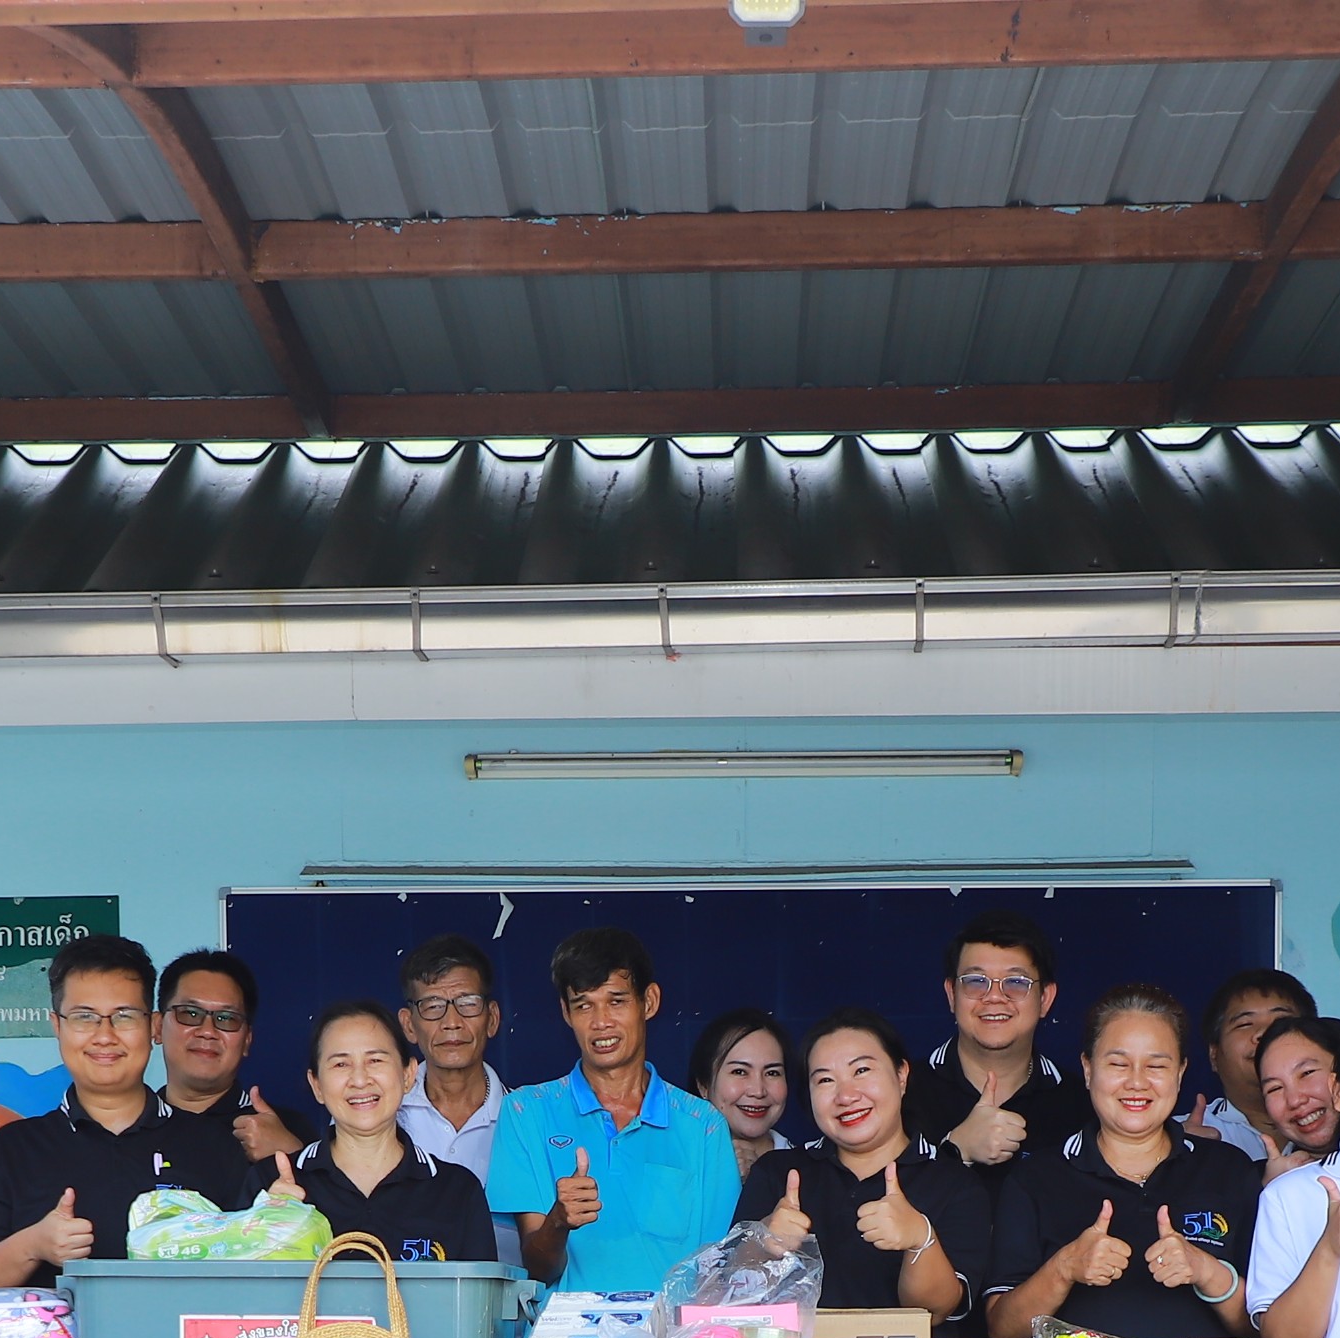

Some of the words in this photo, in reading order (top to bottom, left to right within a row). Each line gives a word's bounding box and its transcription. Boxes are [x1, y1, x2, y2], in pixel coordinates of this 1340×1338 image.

[1182, 1211, 1215, 1236] 51
[181, 1245, 200, 1256] 46
[400, 1238, 431, 1261] 51
